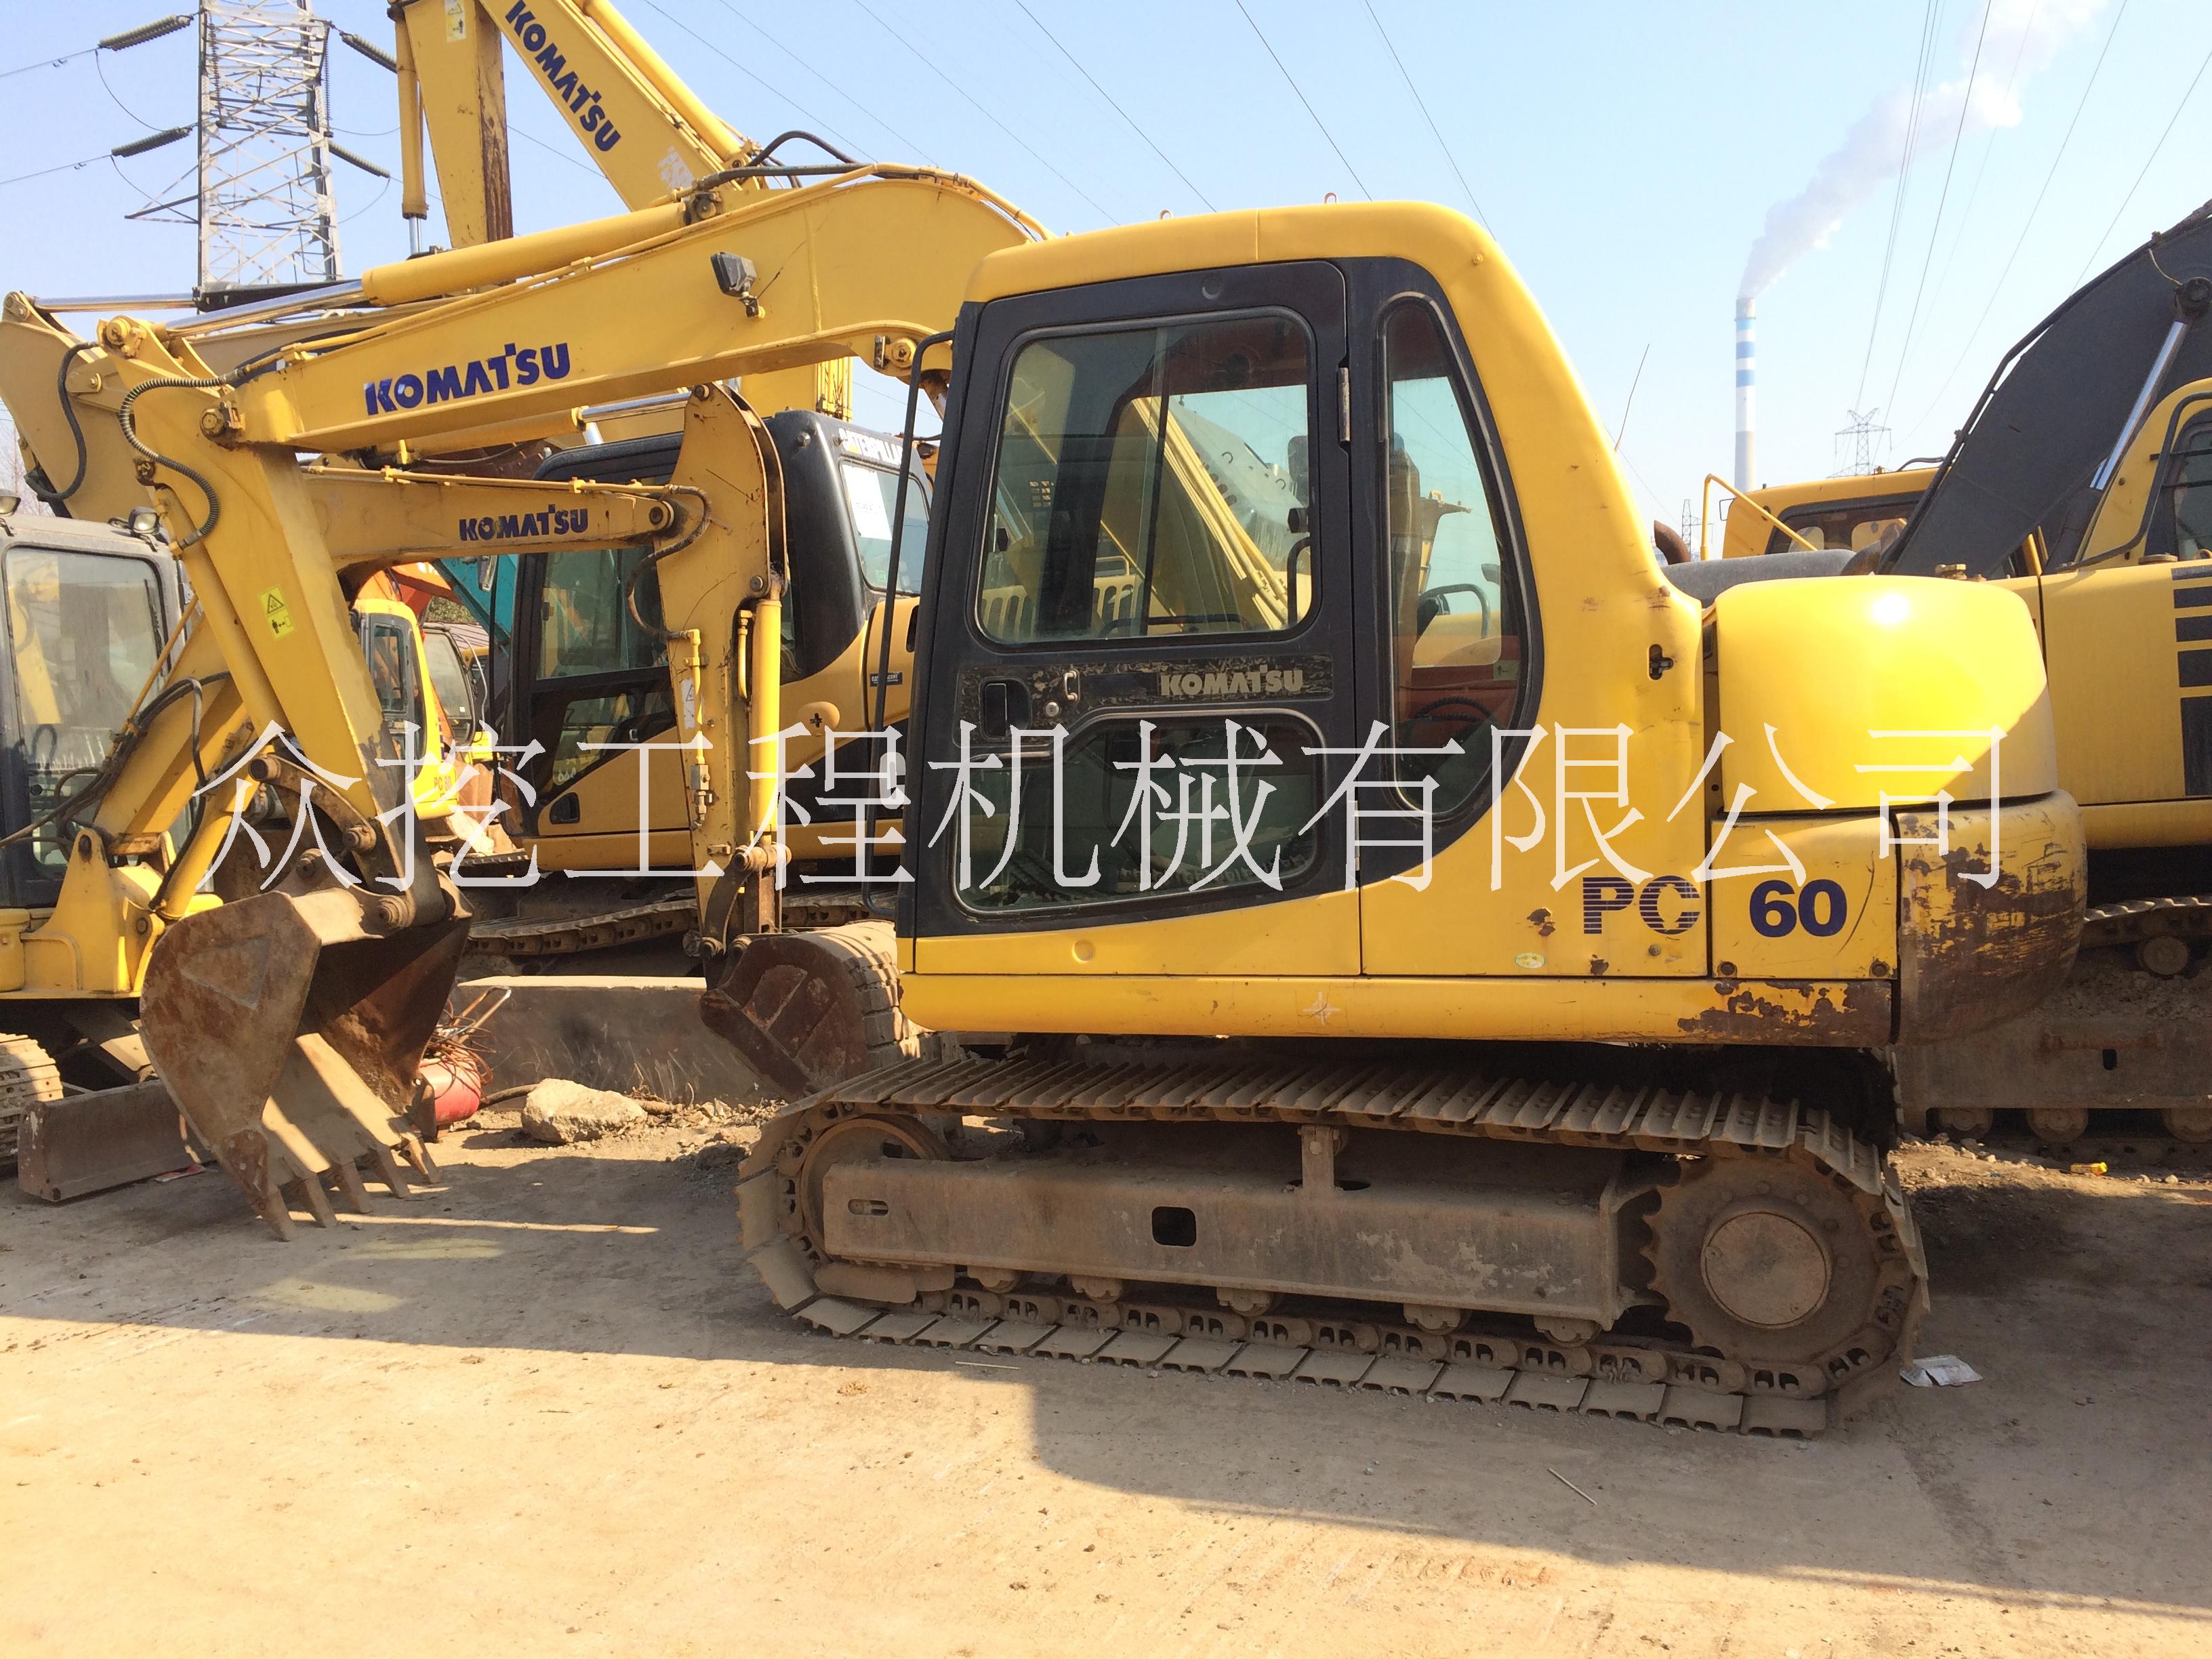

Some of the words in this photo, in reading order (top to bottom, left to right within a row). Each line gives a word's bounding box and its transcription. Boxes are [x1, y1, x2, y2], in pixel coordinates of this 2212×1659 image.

[505, 0, 621, 152] KOMATSU
[363, 342, 571, 415] KOMATSU
[459, 504, 588, 541] KOMATSU
[1161, 664, 1303, 695] KOMATSU
[1583, 875, 1701, 935] PC
[1749, 879, 1847, 938] 60
